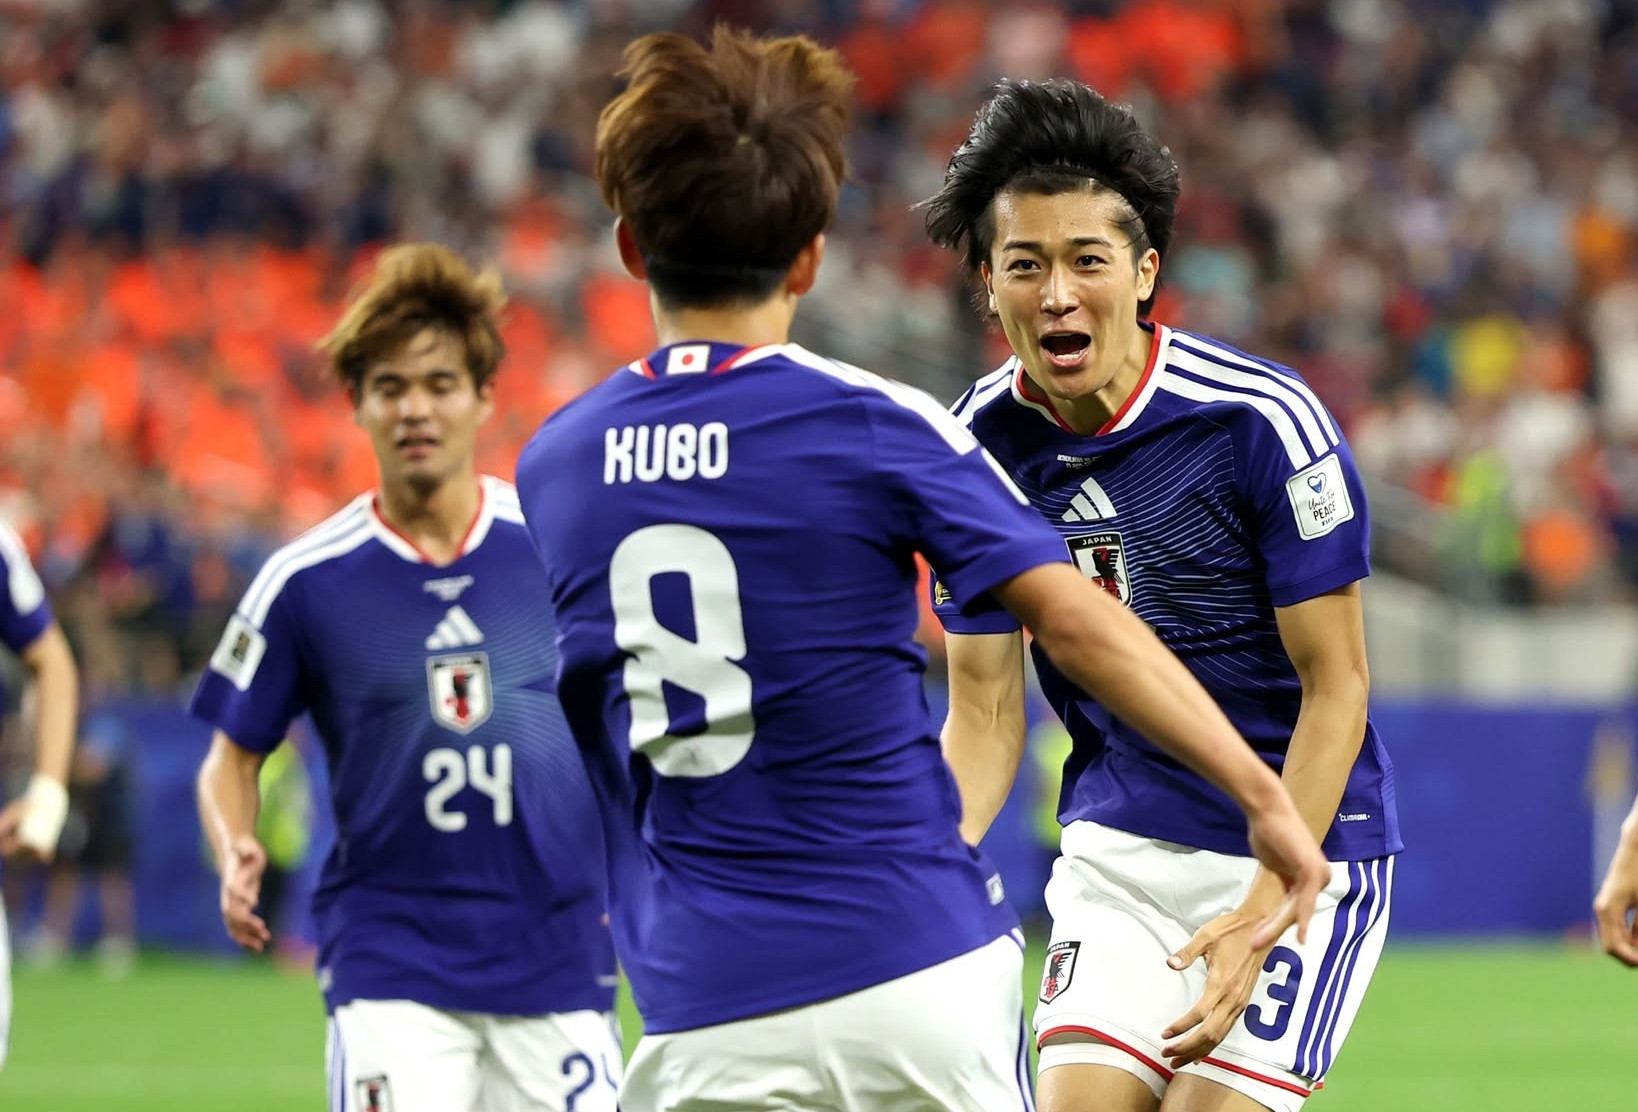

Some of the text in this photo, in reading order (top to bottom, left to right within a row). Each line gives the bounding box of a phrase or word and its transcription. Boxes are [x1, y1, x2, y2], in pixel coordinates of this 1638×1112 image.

[604, 422, 728, 484] KUBO
[1082, 535, 1113, 546] JAPAN
[1313, 501, 1336, 521] PEACE
[609, 523, 756, 778] 8
[422, 742, 514, 833] 24
